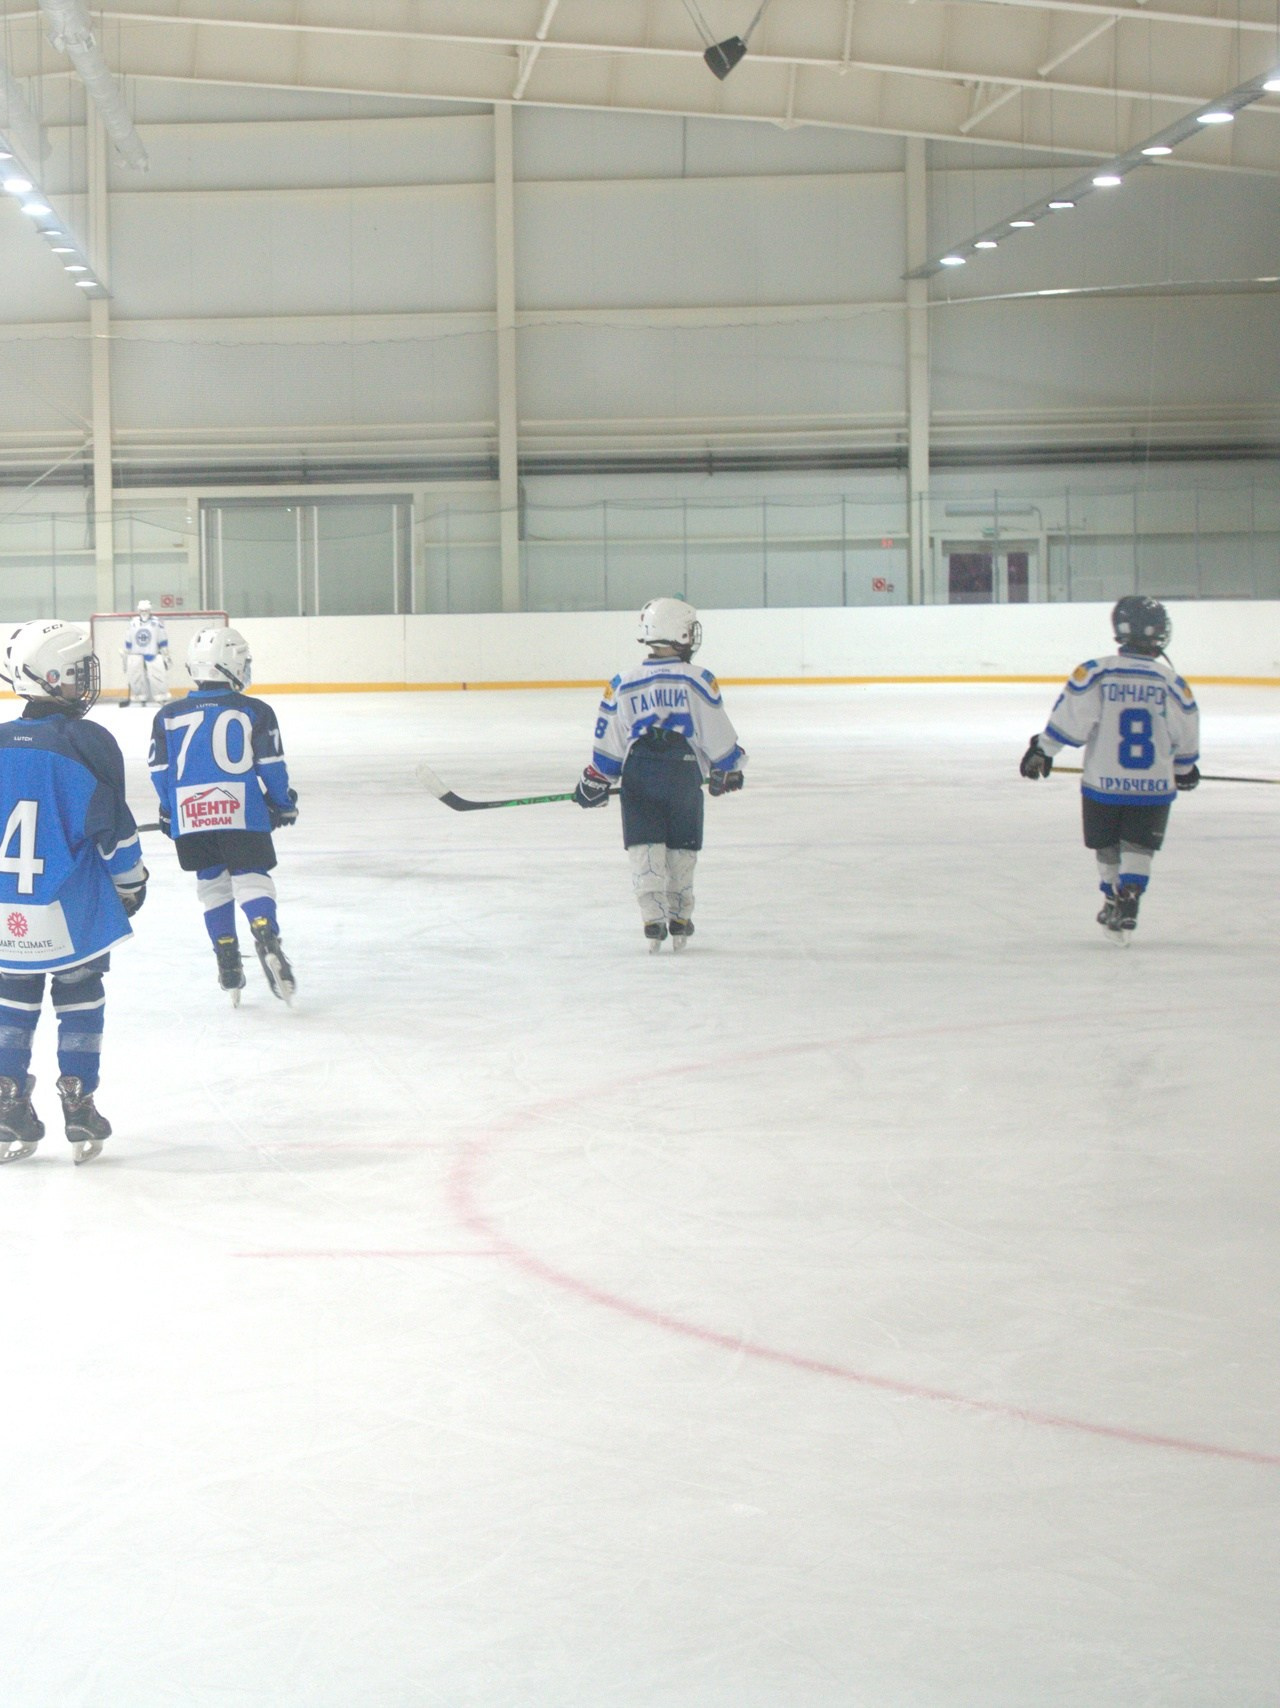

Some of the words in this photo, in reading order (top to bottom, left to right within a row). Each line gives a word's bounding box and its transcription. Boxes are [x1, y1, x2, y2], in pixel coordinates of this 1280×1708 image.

[163, 708, 255, 781] 70
[1118, 708, 1155, 770] 8
[184, 799, 241, 820] ЦЕНТР
[18, 939, 54, 949] CLIMATE
